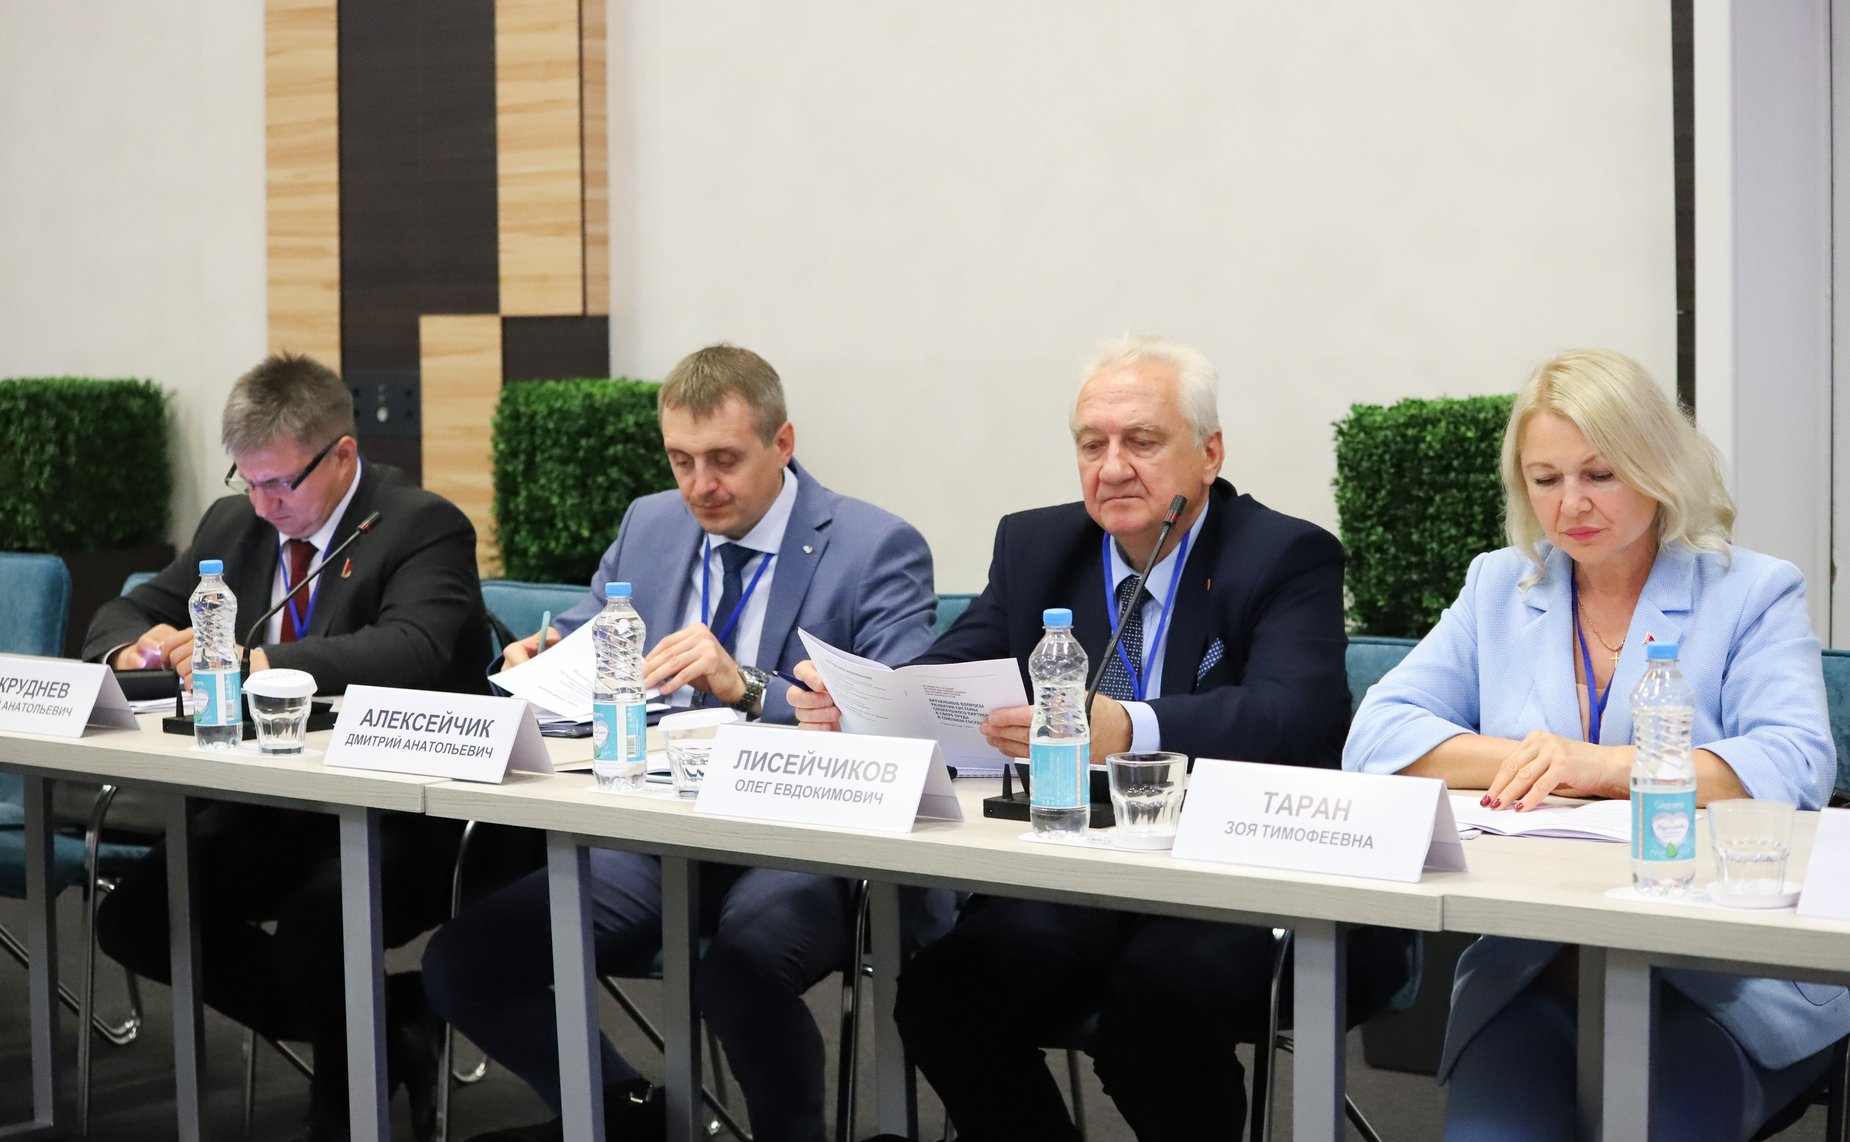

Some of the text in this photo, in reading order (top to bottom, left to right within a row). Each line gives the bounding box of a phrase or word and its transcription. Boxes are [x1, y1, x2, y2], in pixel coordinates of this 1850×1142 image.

[1, 701, 74, 717] АНАТОЛЬЕВИЧ
[359, 708, 495, 738] АЛЕКСЕЙЧИК
[344, 733, 493, 758] ДМИТРИЙ АНАТОЛЬЕВИЧ
[733, 750, 898, 784] ЛИСЕЙЧИКОВ
[734, 779, 884, 805] ОЛЕГ ЕВДОКИМОВИЧ
[1263, 791, 1352, 822] ТАРАН
[1224, 821, 1374, 850] ЗОЯ ТИМОФЕЕВНА
